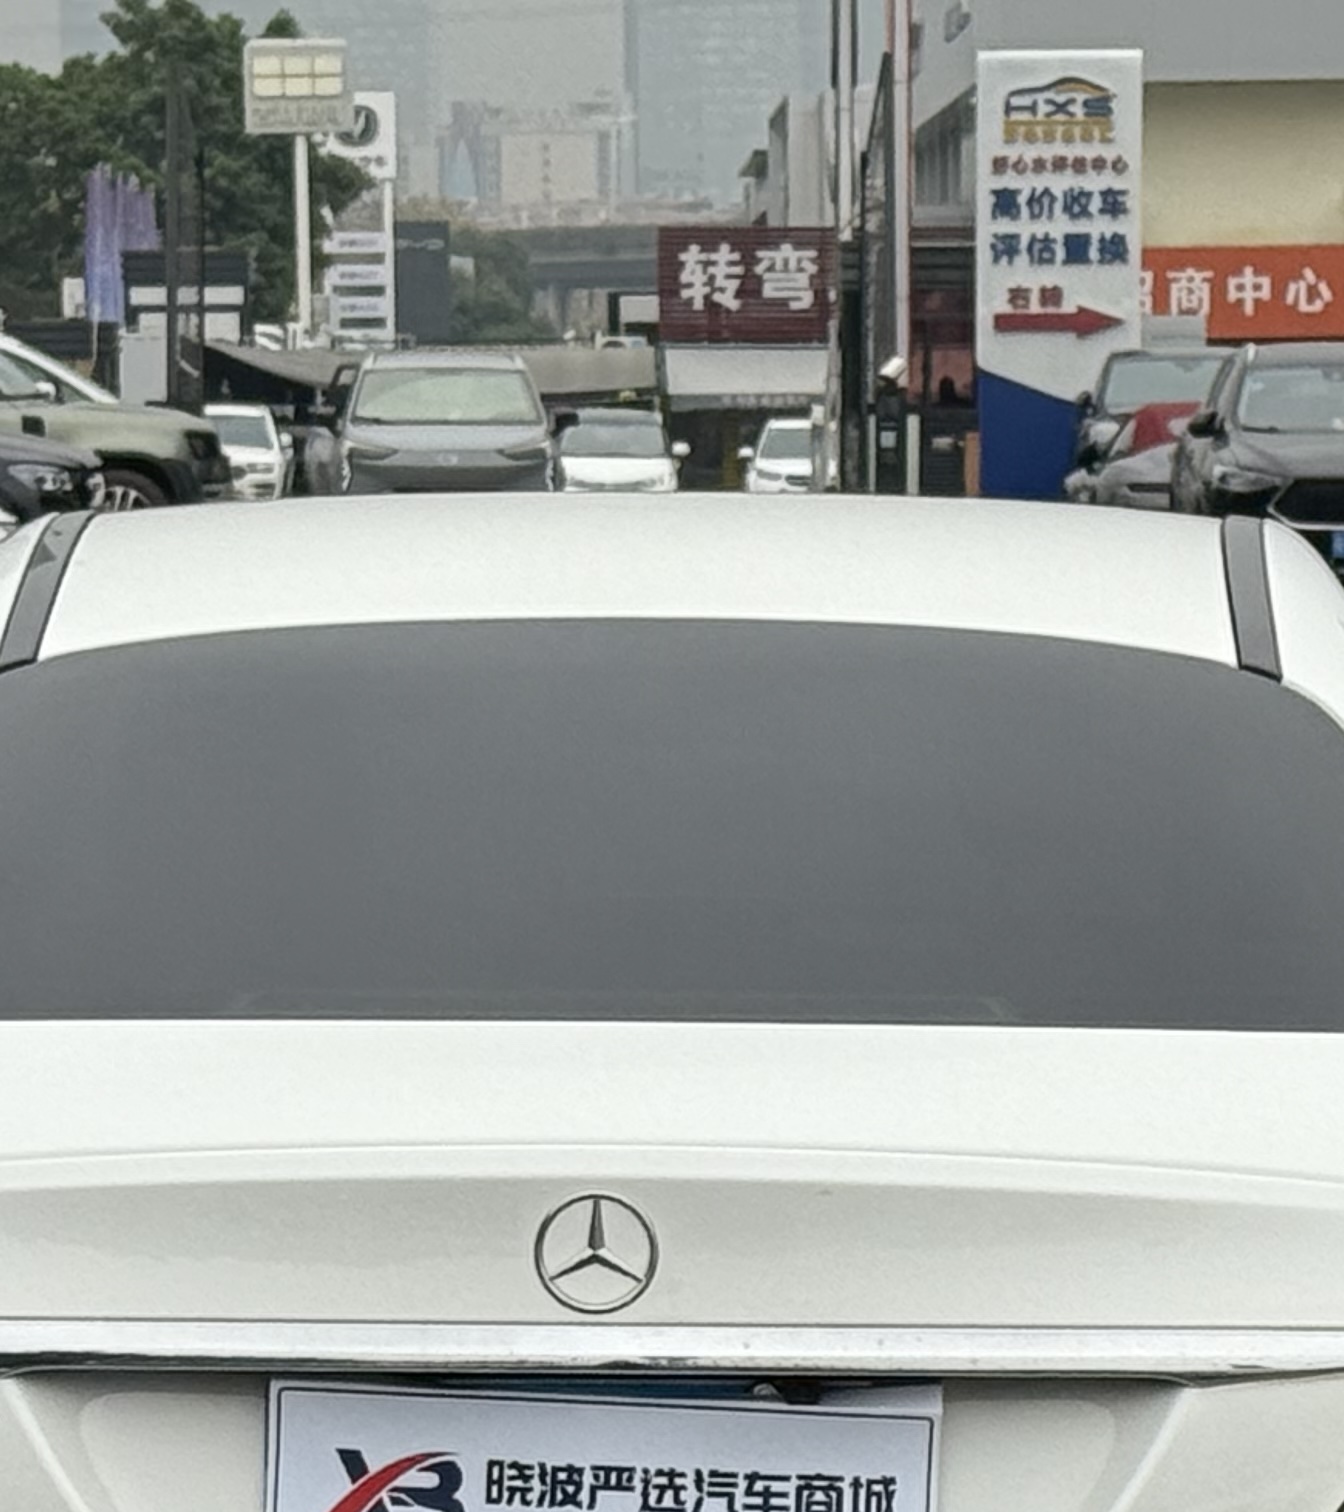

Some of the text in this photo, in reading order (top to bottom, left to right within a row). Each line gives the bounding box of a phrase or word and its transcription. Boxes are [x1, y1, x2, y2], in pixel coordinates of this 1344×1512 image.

[990, 186, 1131, 222] 高价收车
[989, 231, 1130, 267] 评估置换
[678, 242, 820, 312] 转弯
